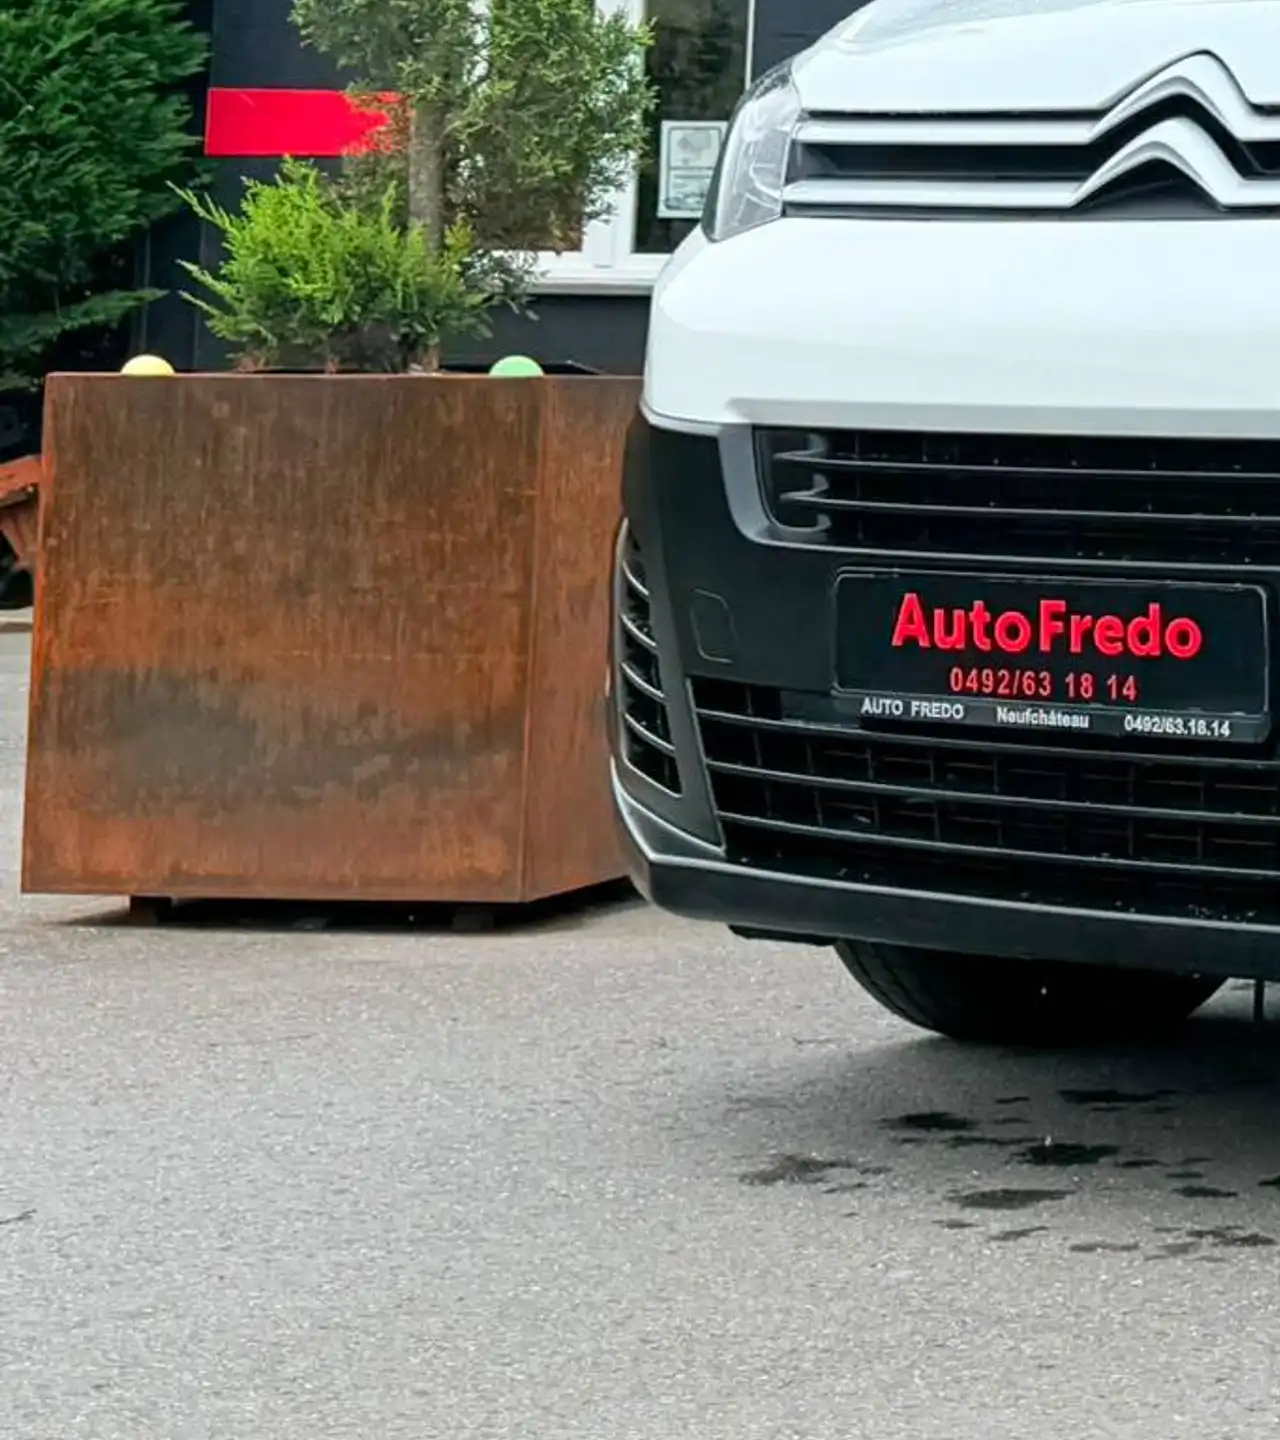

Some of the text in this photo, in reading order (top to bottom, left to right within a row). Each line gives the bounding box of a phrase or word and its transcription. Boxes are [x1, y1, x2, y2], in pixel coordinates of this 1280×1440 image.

[891, 592, 1202, 659] AutoFredo
[949, 666, 1138, 702] 0492/63 18 14
[861, 696, 1231, 737] AUTO FREDO Neufchâteau 0492/63.18.14
